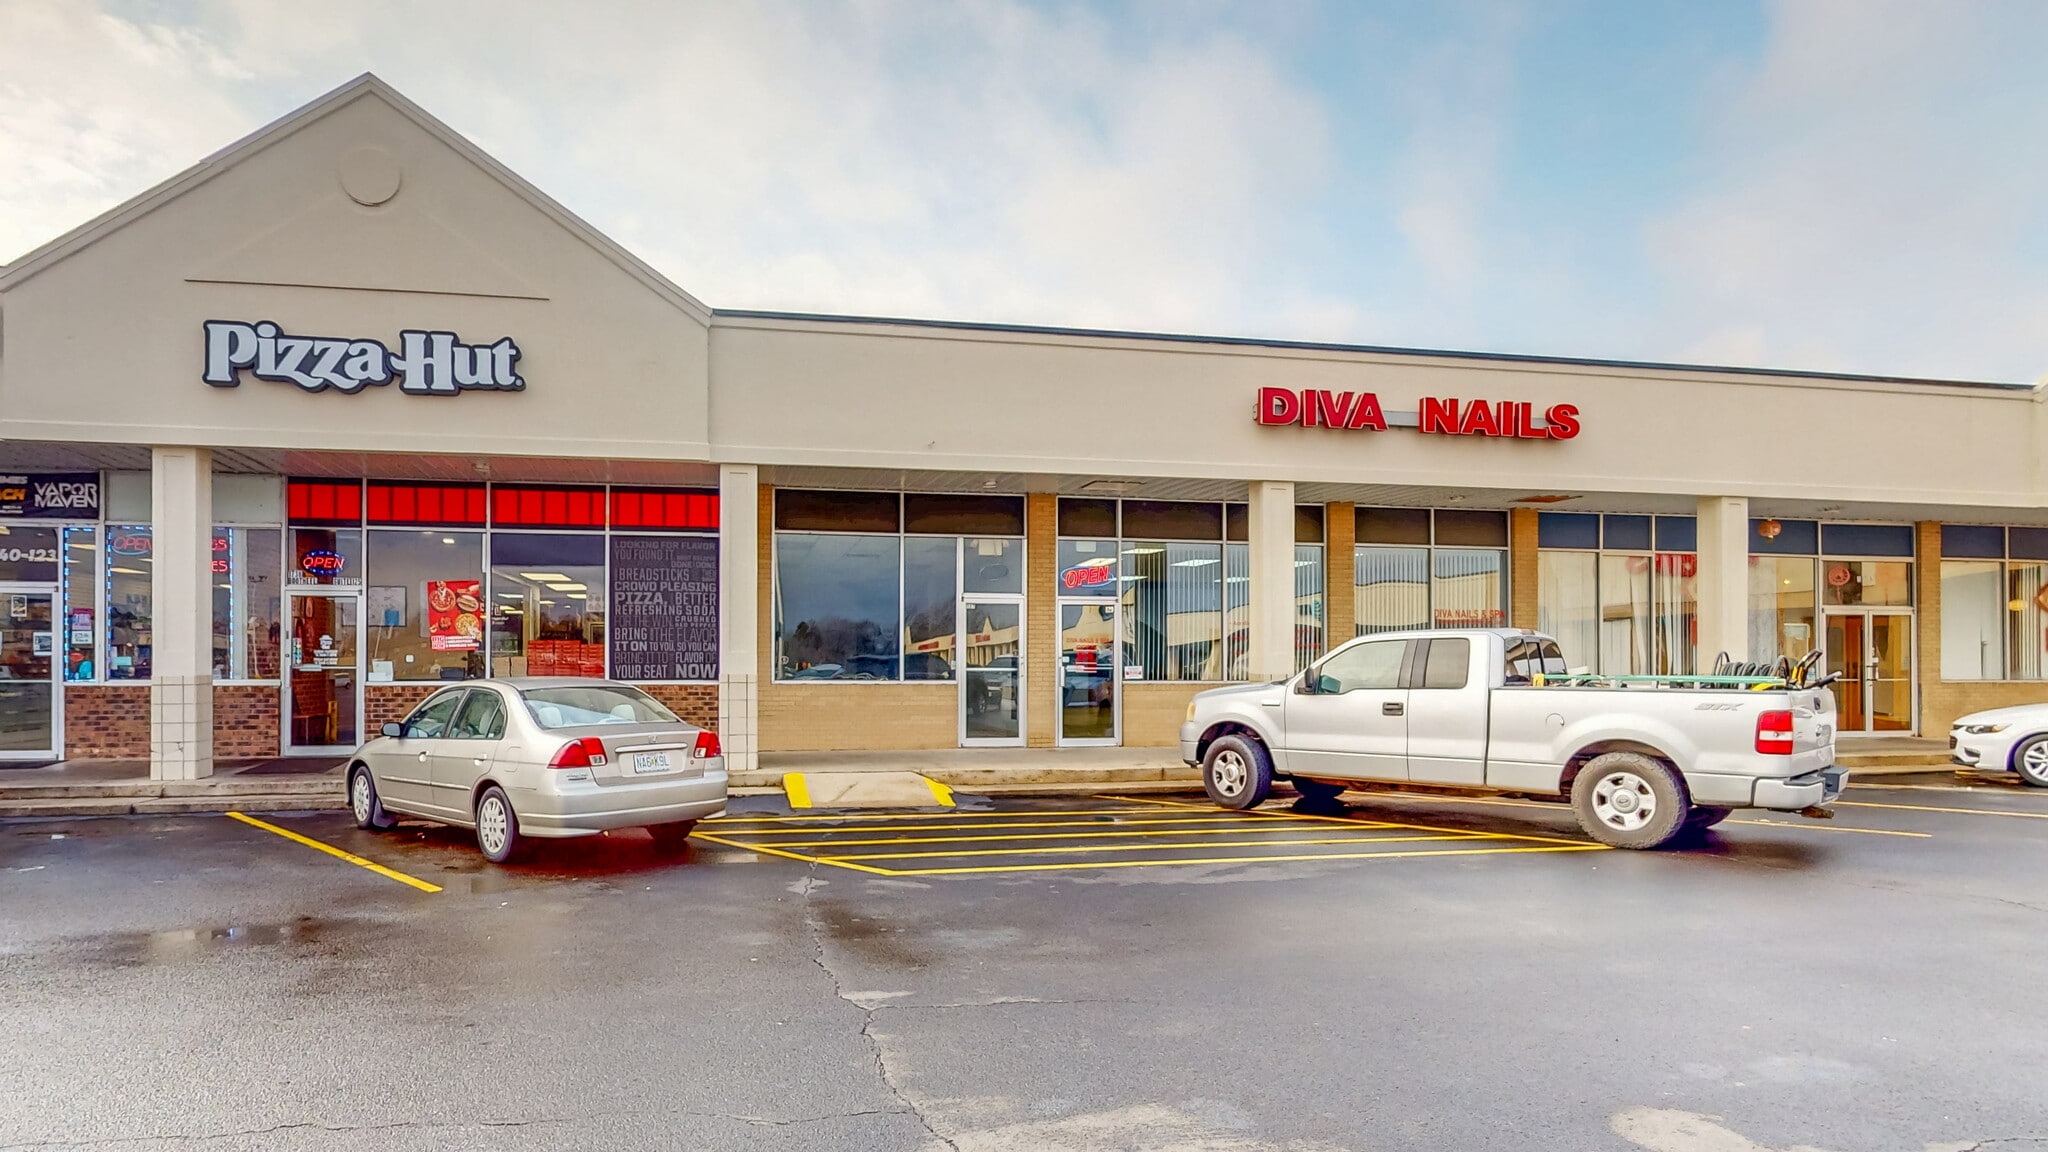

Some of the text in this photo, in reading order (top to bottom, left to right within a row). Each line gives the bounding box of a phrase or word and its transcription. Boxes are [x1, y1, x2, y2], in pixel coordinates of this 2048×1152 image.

[204, 321, 389, 391] Pizza
[1257, 387, 1581, 440] DIVA NAILS
[34, 482, 98, 496] VAPOR
[34, 494, 98, 508] MAVEN
[614, 541, 716, 550] LOOKING FOR FLAVOR
[614, 549, 632, 560] YOU
[633, 549, 663, 560] FOUND
[303, 556, 345, 570] OPEN
[619, 567, 690, 581] BREADSTICKS
[1065, 566, 1110, 588] OPEN
[614, 581, 717, 592] CROWD PLEASING
[675, 592, 717, 606] BETTER
[614, 604, 716, 616] REFRESHING SODA
[1434, 608, 1453, 618] DIVA
[1455, 609, 1479, 619] NAILS
[675, 615, 717, 623] CRUSHED
[614, 627, 648, 641] BRING
[653, 628, 674, 641] THE
[676, 628, 717, 641] FLAVOR
[614, 641, 648, 651] IT ON
[649, 642, 659, 651] TO
[677, 642, 687, 651] SO
[687, 642, 702, 651] YOU
[702, 642, 717, 651] CAN
[614, 652, 644, 664] BRING
[675, 652, 704, 663] FLAVOR
[614, 664, 668, 679] YOUR SEAT
[675, 663, 717, 679] NOW
